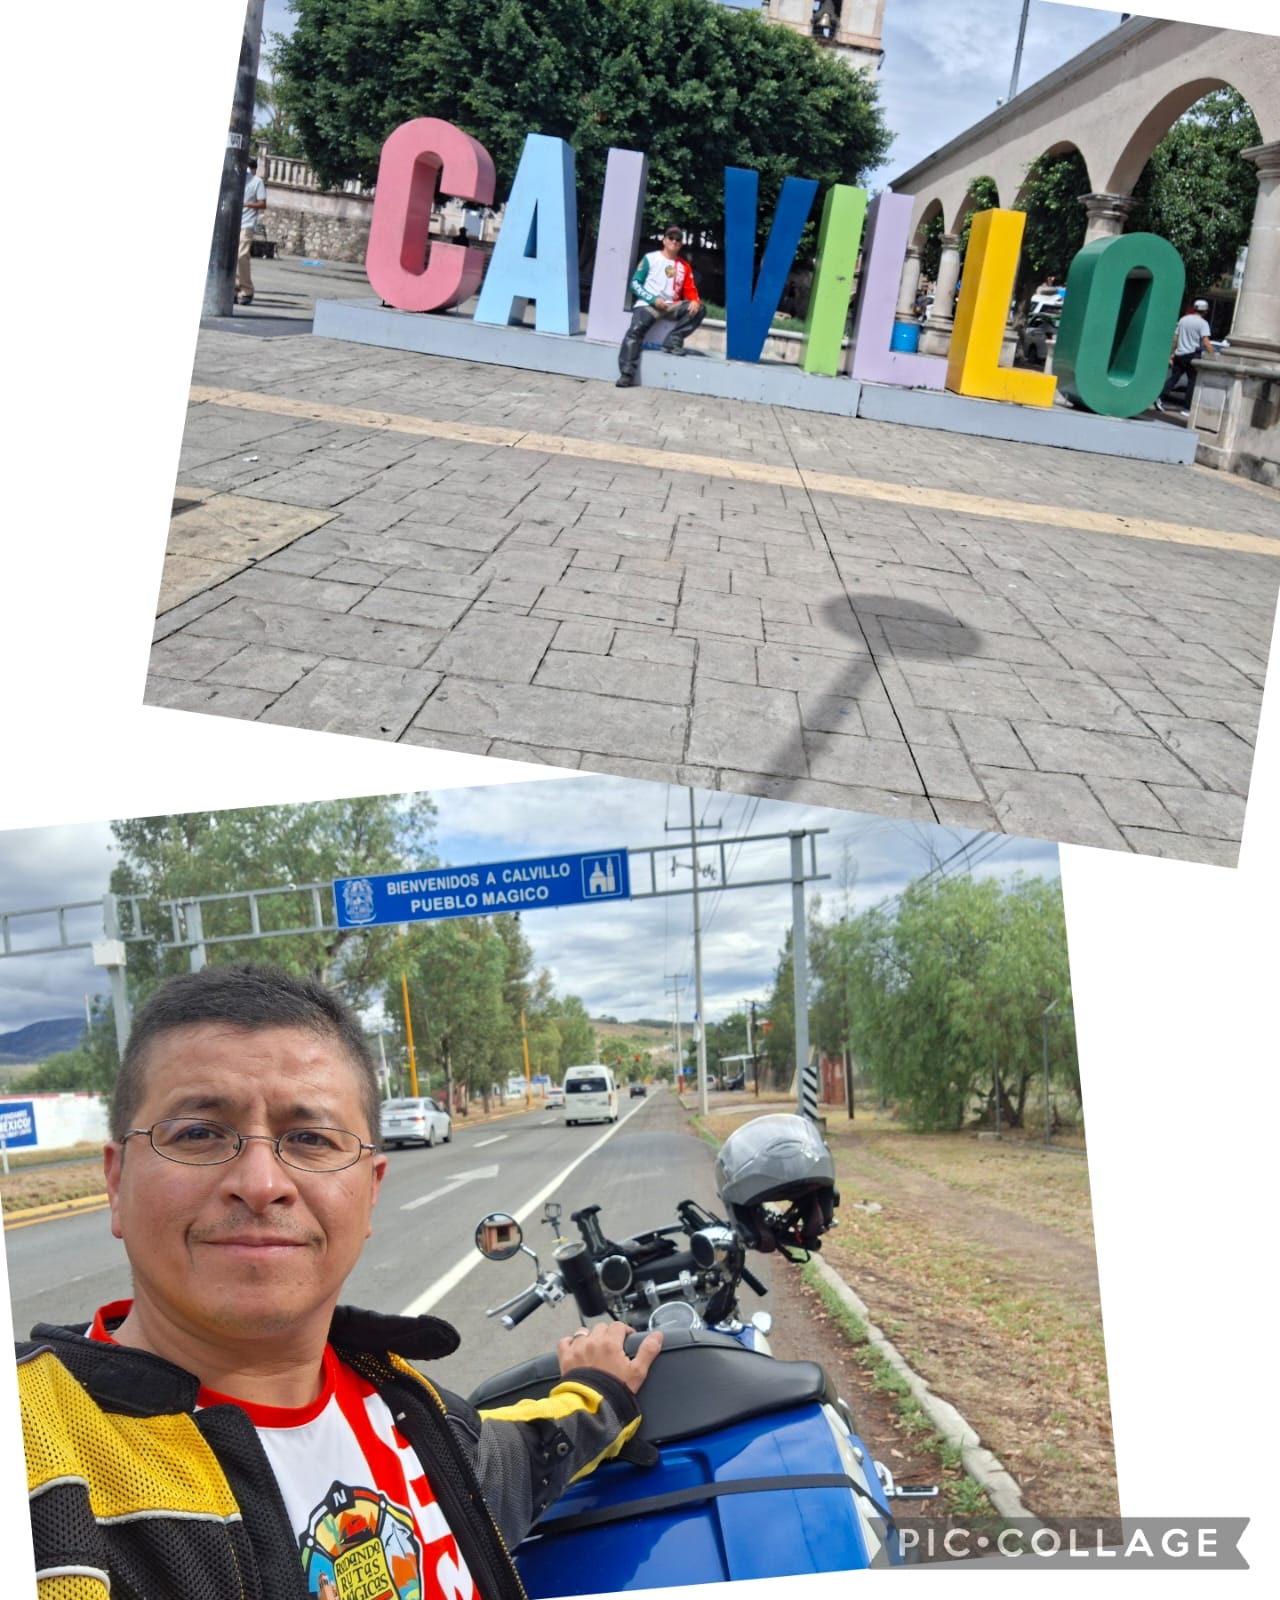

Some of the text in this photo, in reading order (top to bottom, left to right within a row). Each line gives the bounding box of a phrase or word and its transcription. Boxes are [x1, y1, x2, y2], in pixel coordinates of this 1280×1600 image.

[366, 117, 1186, 418] CALVILLO
[387, 863, 570, 895] BIENVENIDOS A CALVILLO
[411, 886, 549, 913] PUEBLO MAGICO
[332, 1488, 347, 1507] N
